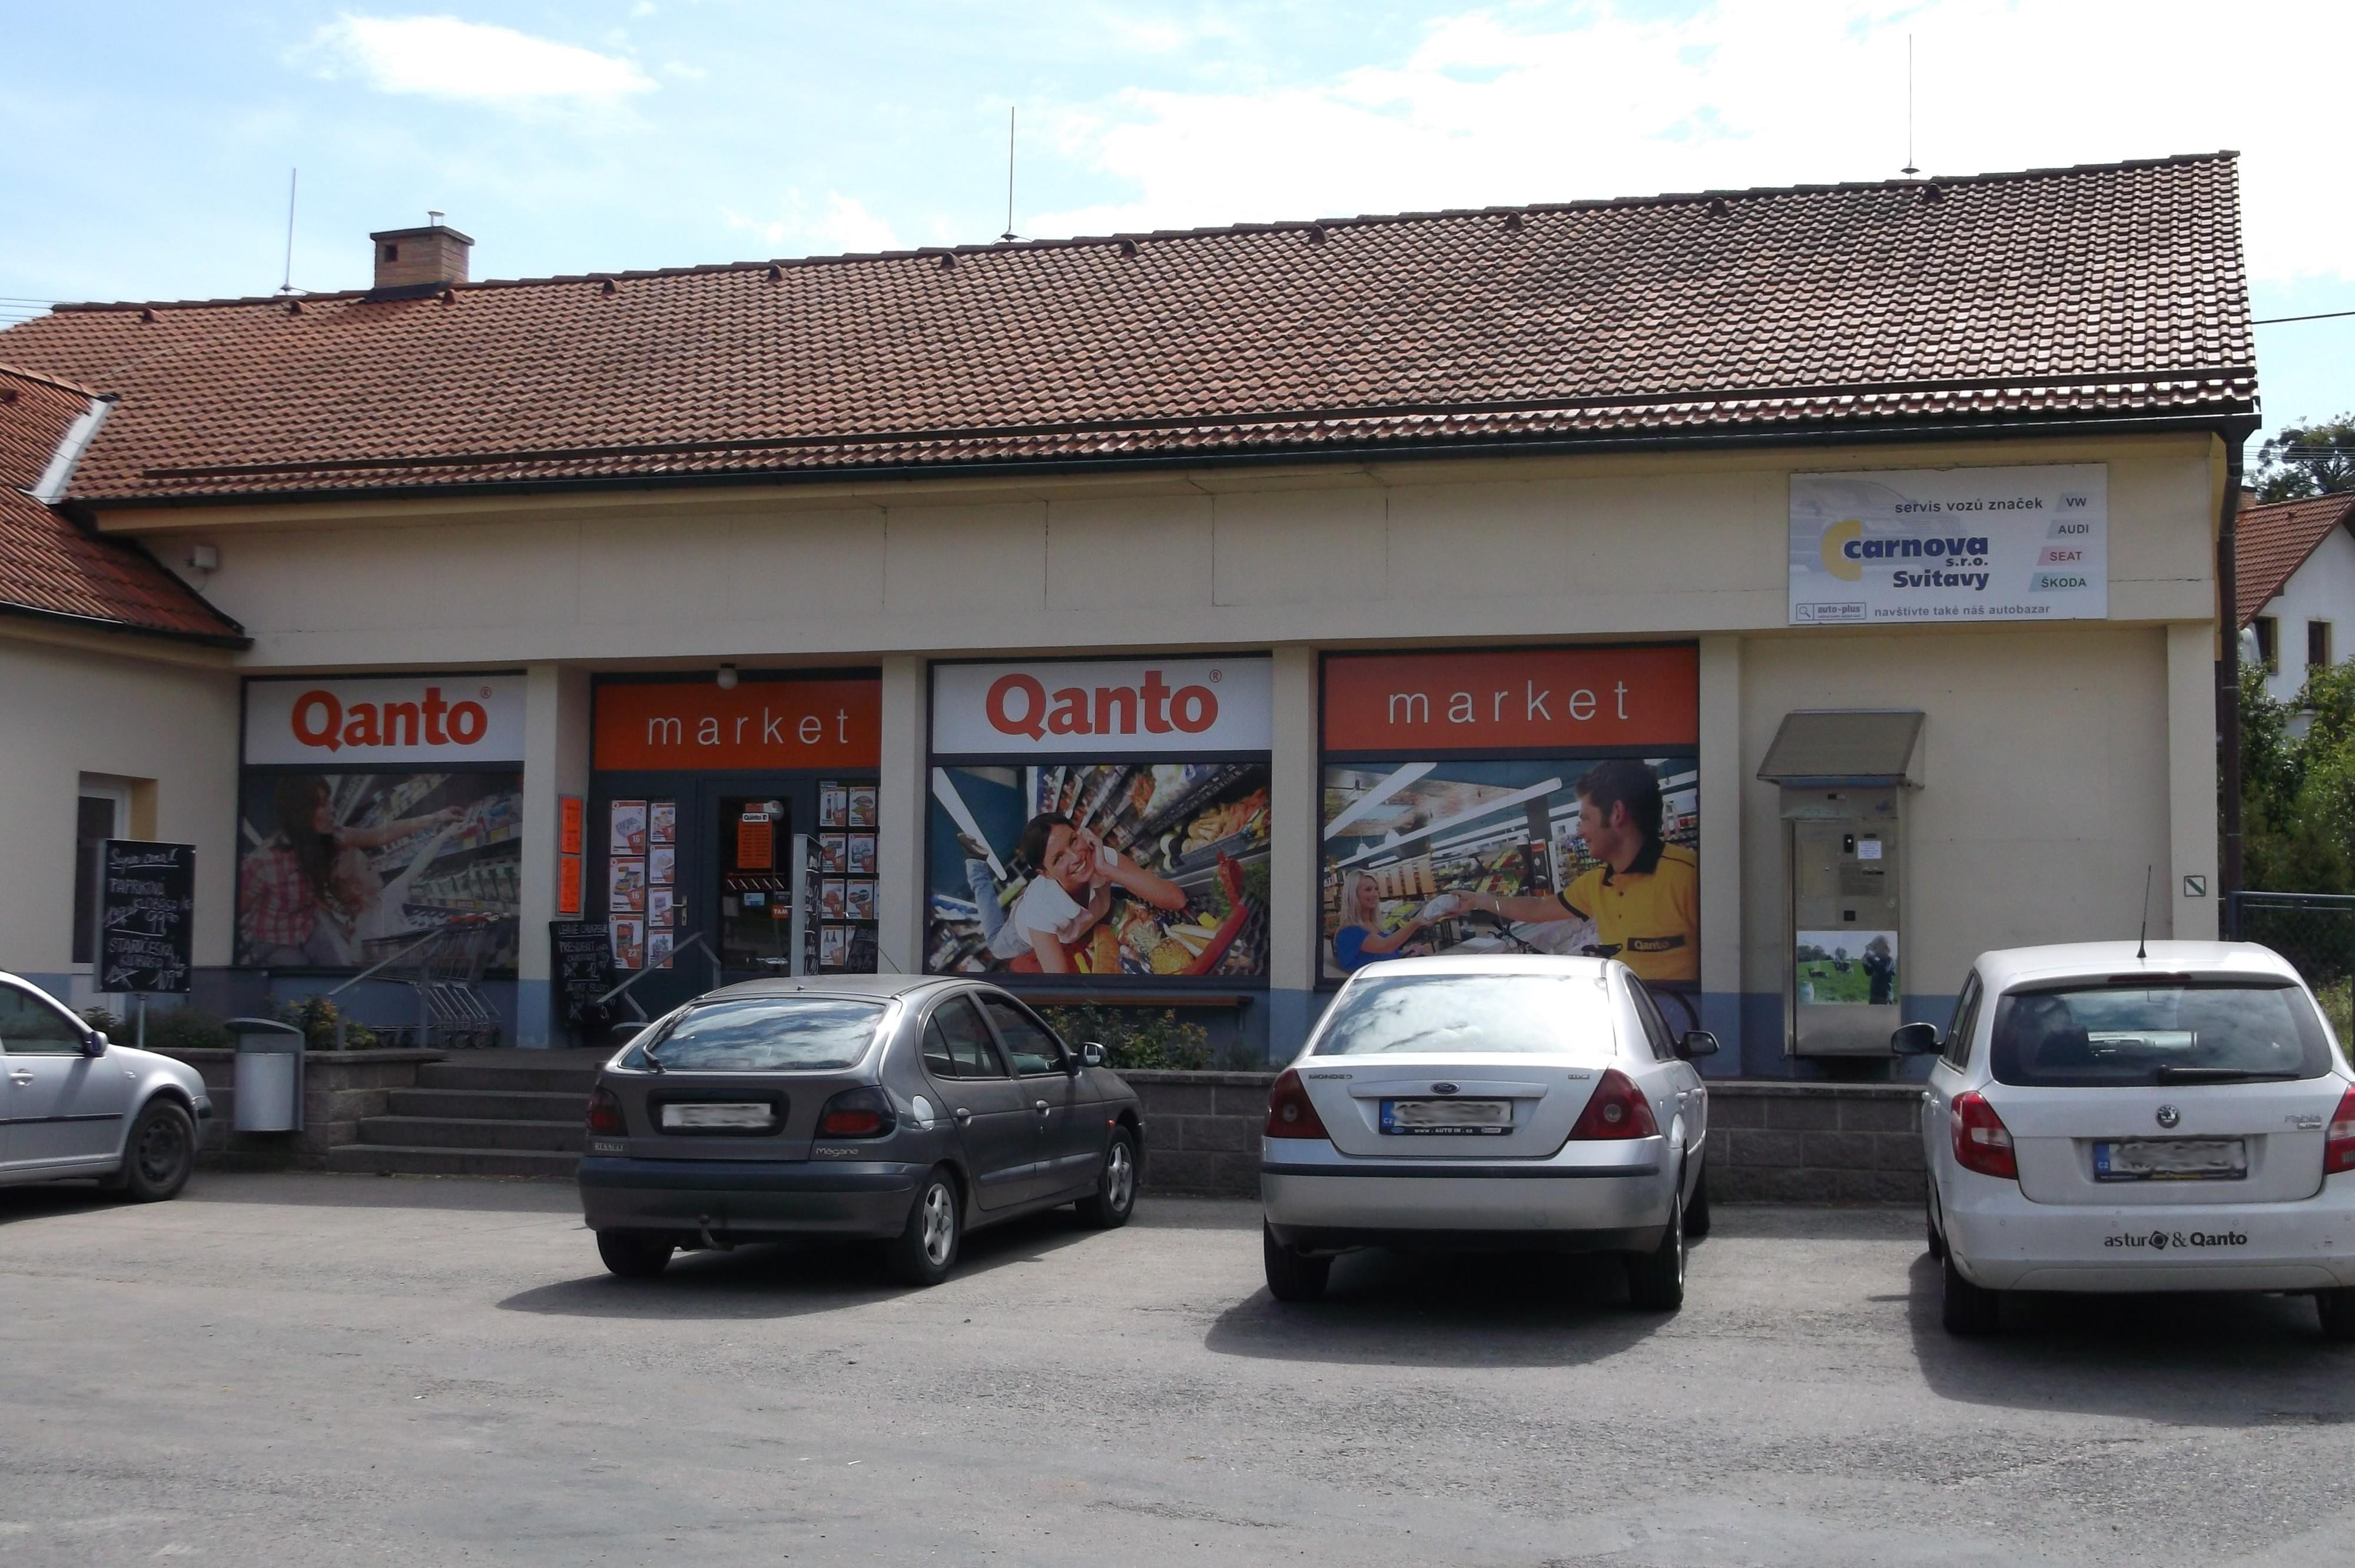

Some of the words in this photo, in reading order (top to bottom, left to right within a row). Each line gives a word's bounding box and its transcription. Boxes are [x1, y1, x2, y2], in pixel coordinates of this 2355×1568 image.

[1895, 501, 1941, 514] servis
[1946, 498, 1982, 512] vozů
[1988, 497, 2043, 511] značek
[2066, 497, 2087, 507] VW
[2058, 524, 2089, 535] AUDI
[1843, 537, 1989, 559] carnova
[2049, 551, 2082, 562] SEAT
[1945, 556, 1988, 567] s.r.o.
[1893, 569, 1989, 591] Svitavy
[2041, 575, 2087, 588] ŠKODA
[1817, 604, 1860, 614] auto-plus
[1933, 605, 1959, 616] také
[1963, 604, 1985, 615] náš
[1989, 604, 2051, 615] autobazar
[985, 670, 1219, 742] Qanto
[1388, 680, 1628, 724] market
[291, 687, 488, 753] Qanto
[648, 707, 848, 746] market
[2172, 1231, 2188, 1248] &
[2190, 1231, 2248, 1248] Qanto
